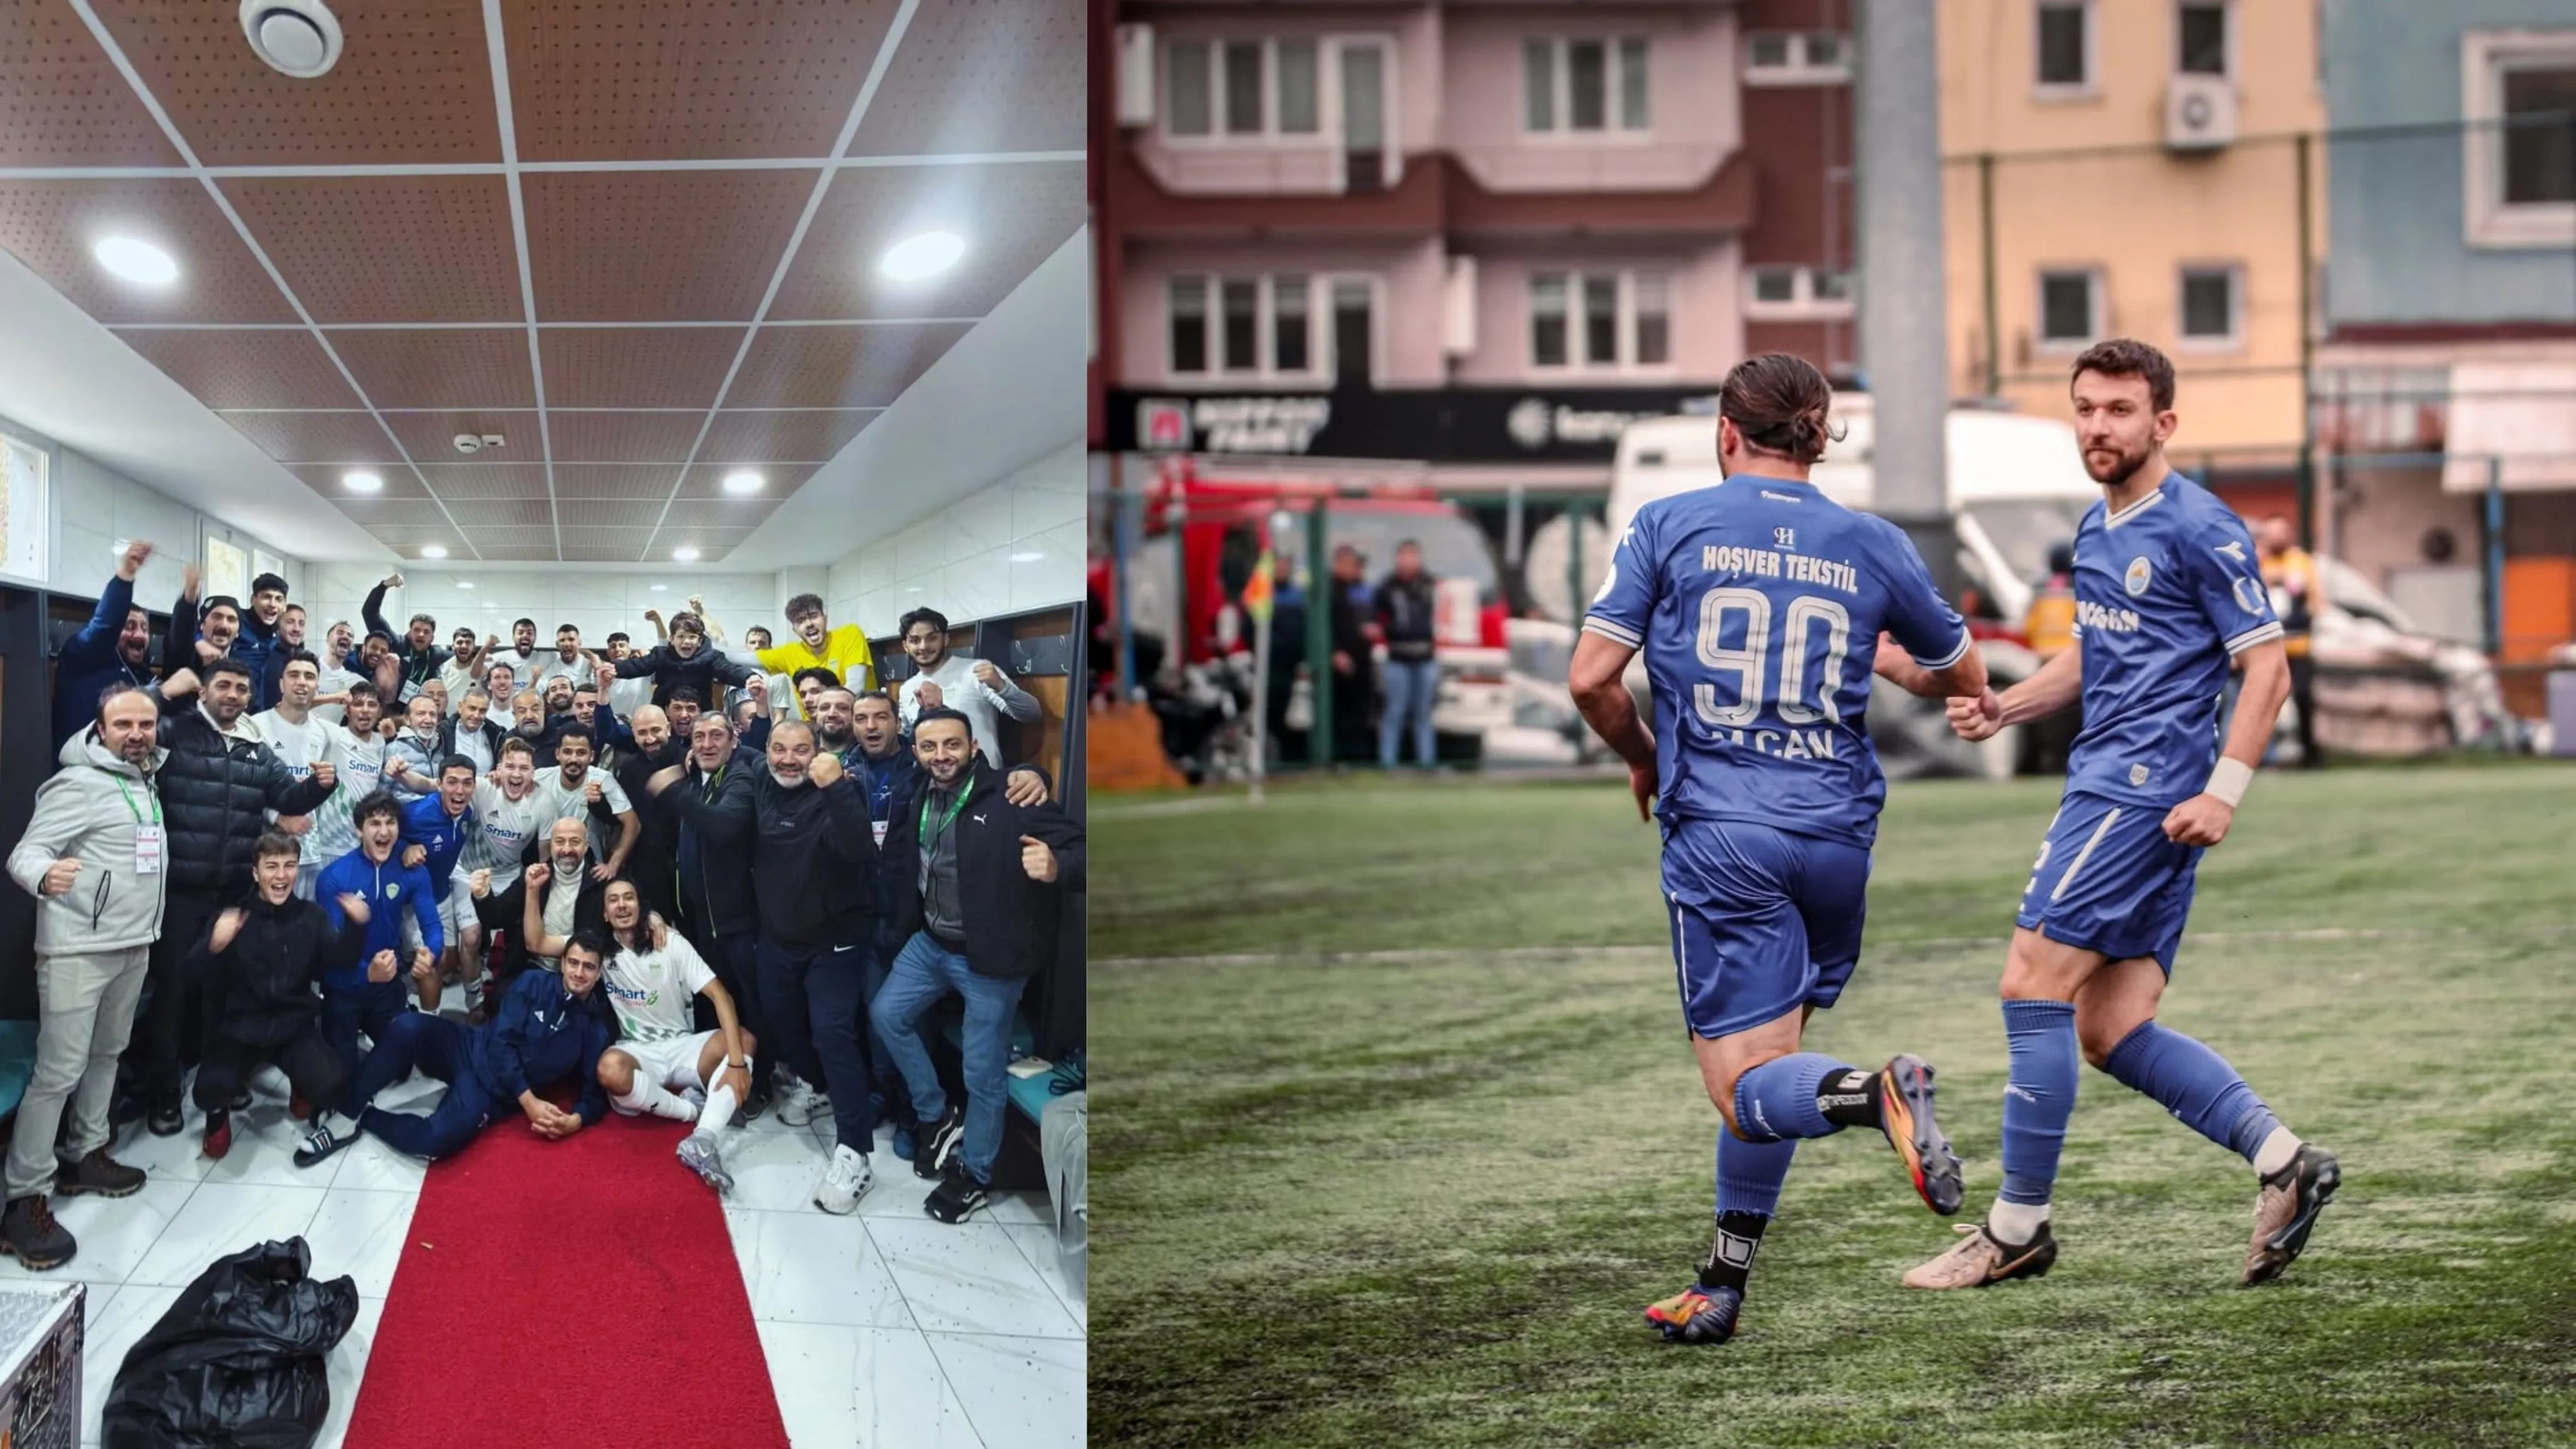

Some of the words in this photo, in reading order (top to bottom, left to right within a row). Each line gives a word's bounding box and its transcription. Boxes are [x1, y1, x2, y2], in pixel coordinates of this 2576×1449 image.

[1703, 545, 1781, 579] HOŞVER
[1786, 554, 1858, 594] TEKSTİL
[1693, 587, 1850, 726] 90
[286, 765, 309, 776] mart
[349, 759, 379, 774] Smart
[485, 823, 522, 840] Smart
[605, 981, 647, 1000] Smart
